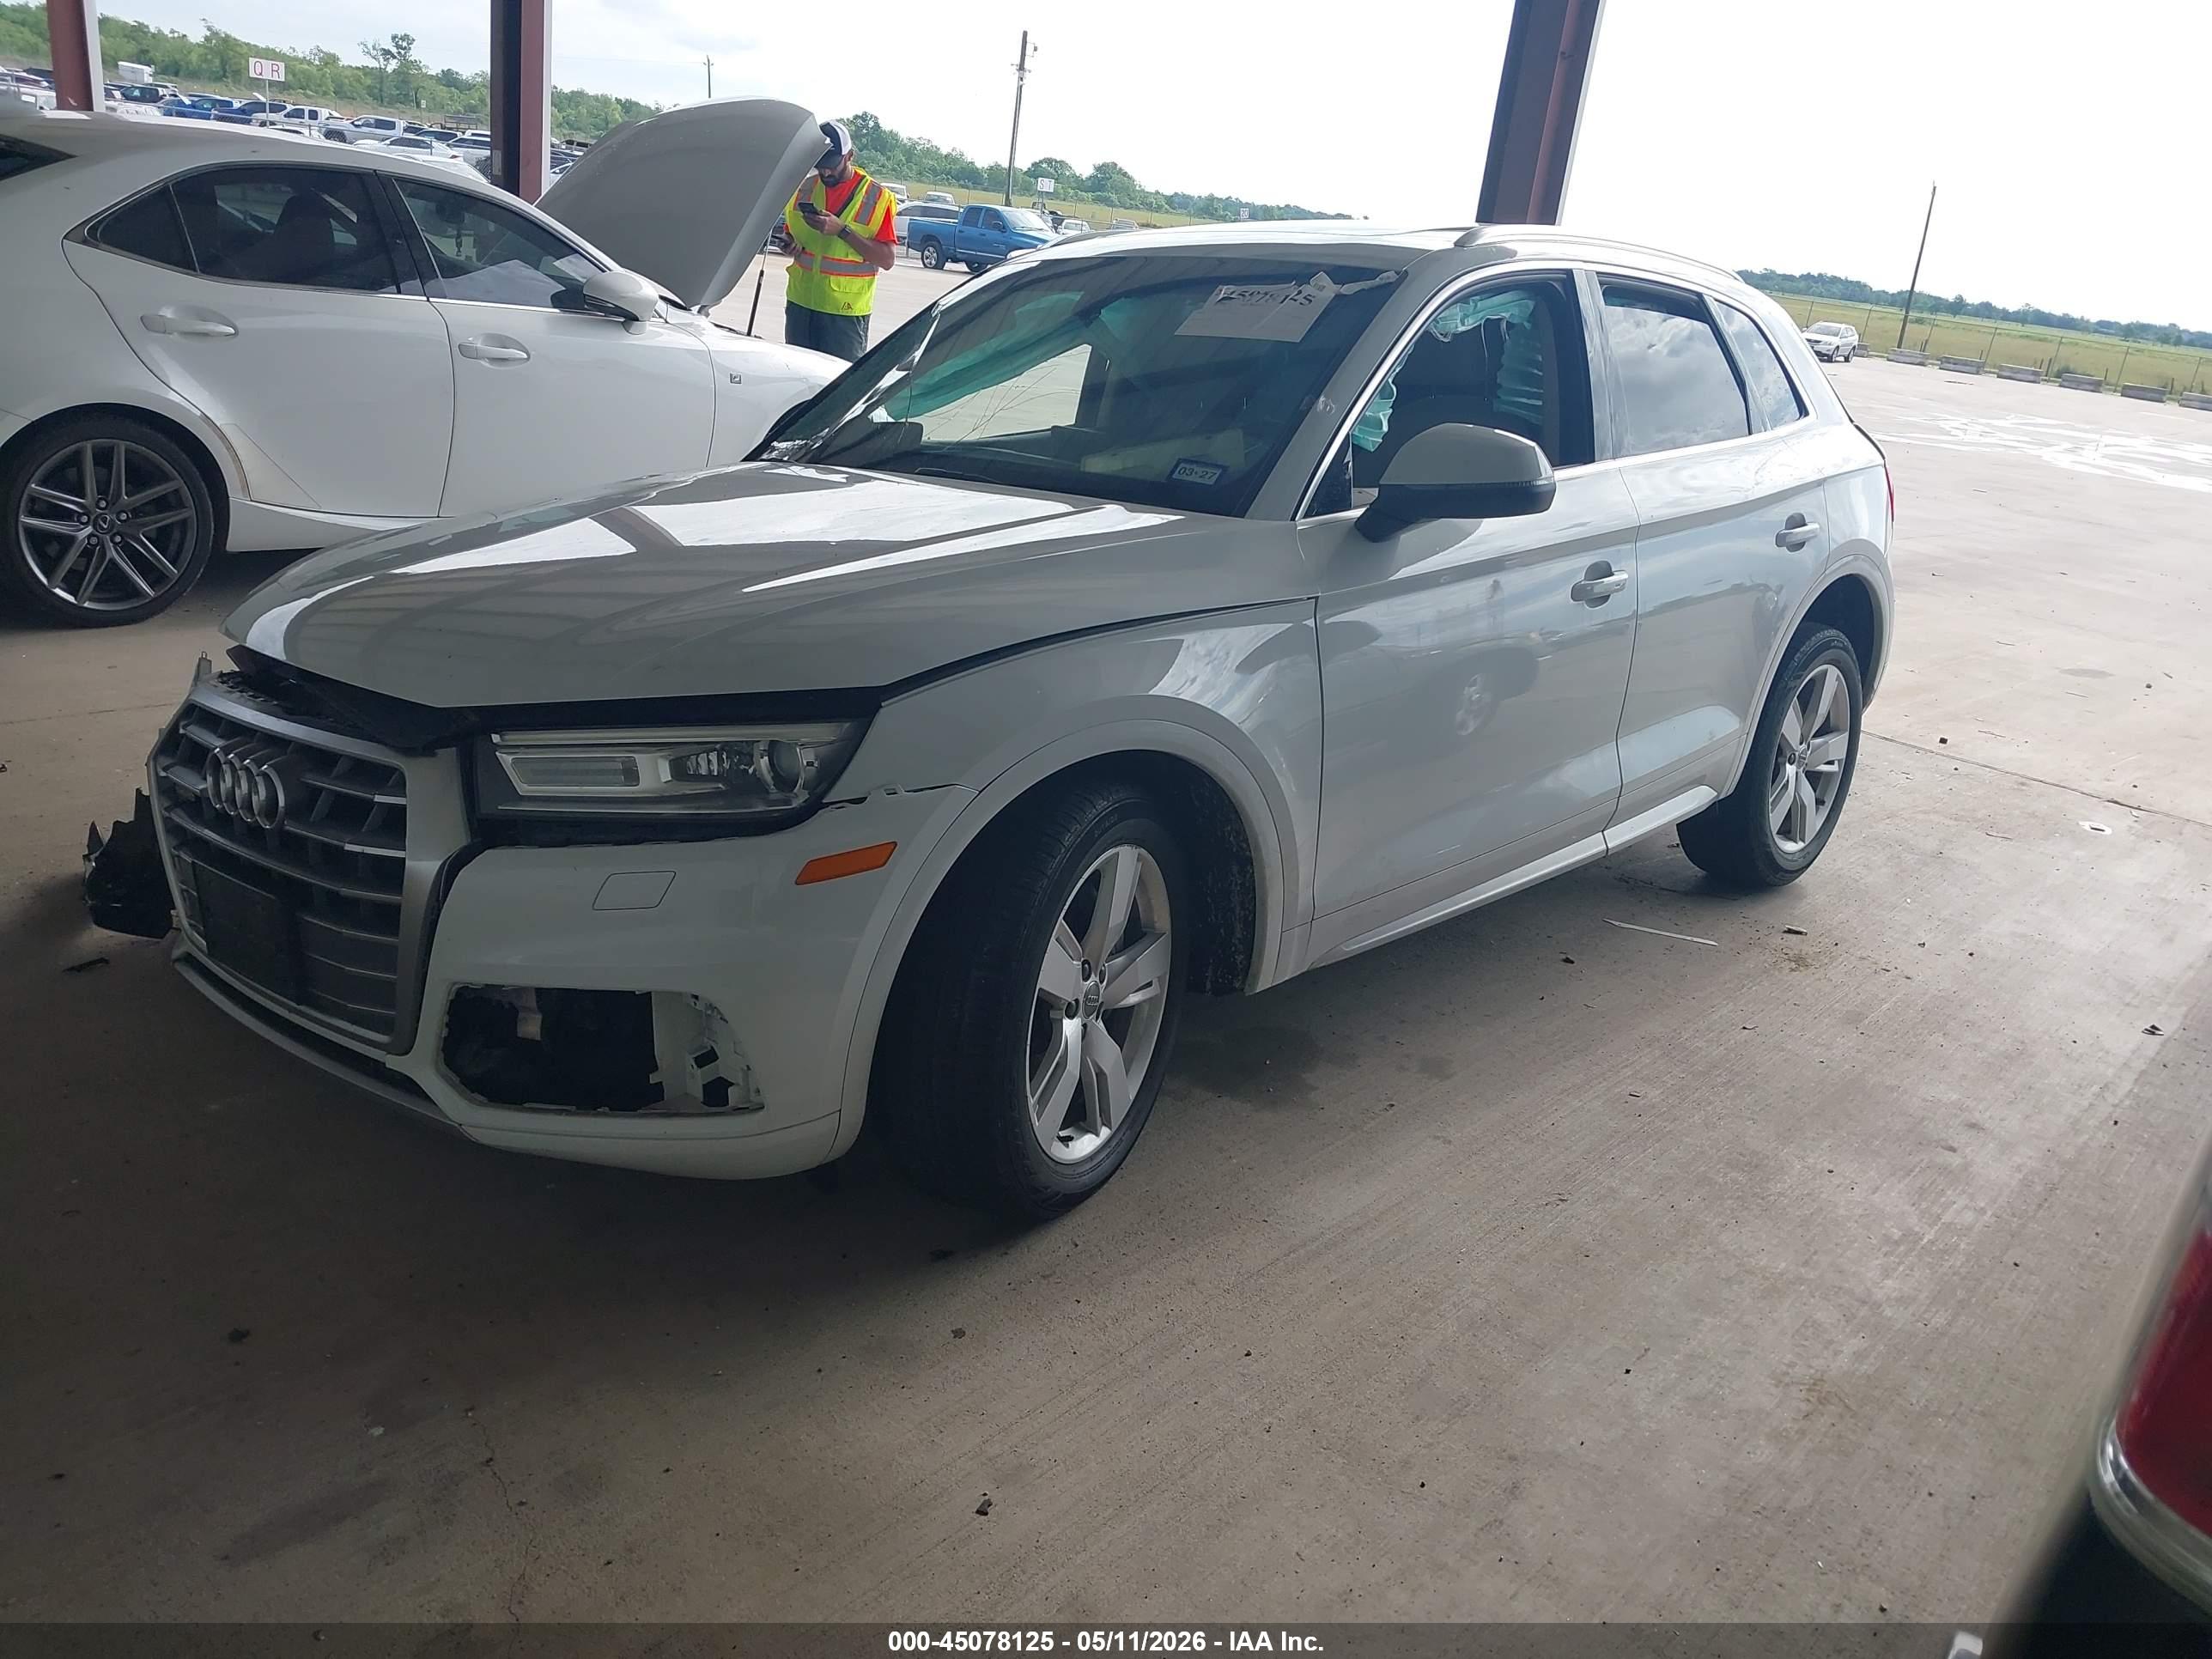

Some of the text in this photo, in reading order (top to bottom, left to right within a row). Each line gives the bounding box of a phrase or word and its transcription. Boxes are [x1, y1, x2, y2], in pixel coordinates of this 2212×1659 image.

[253, 60, 281, 79] Q R
[1039, 179, 1045, 190] S
[1199, 470, 1218, 480] 27
